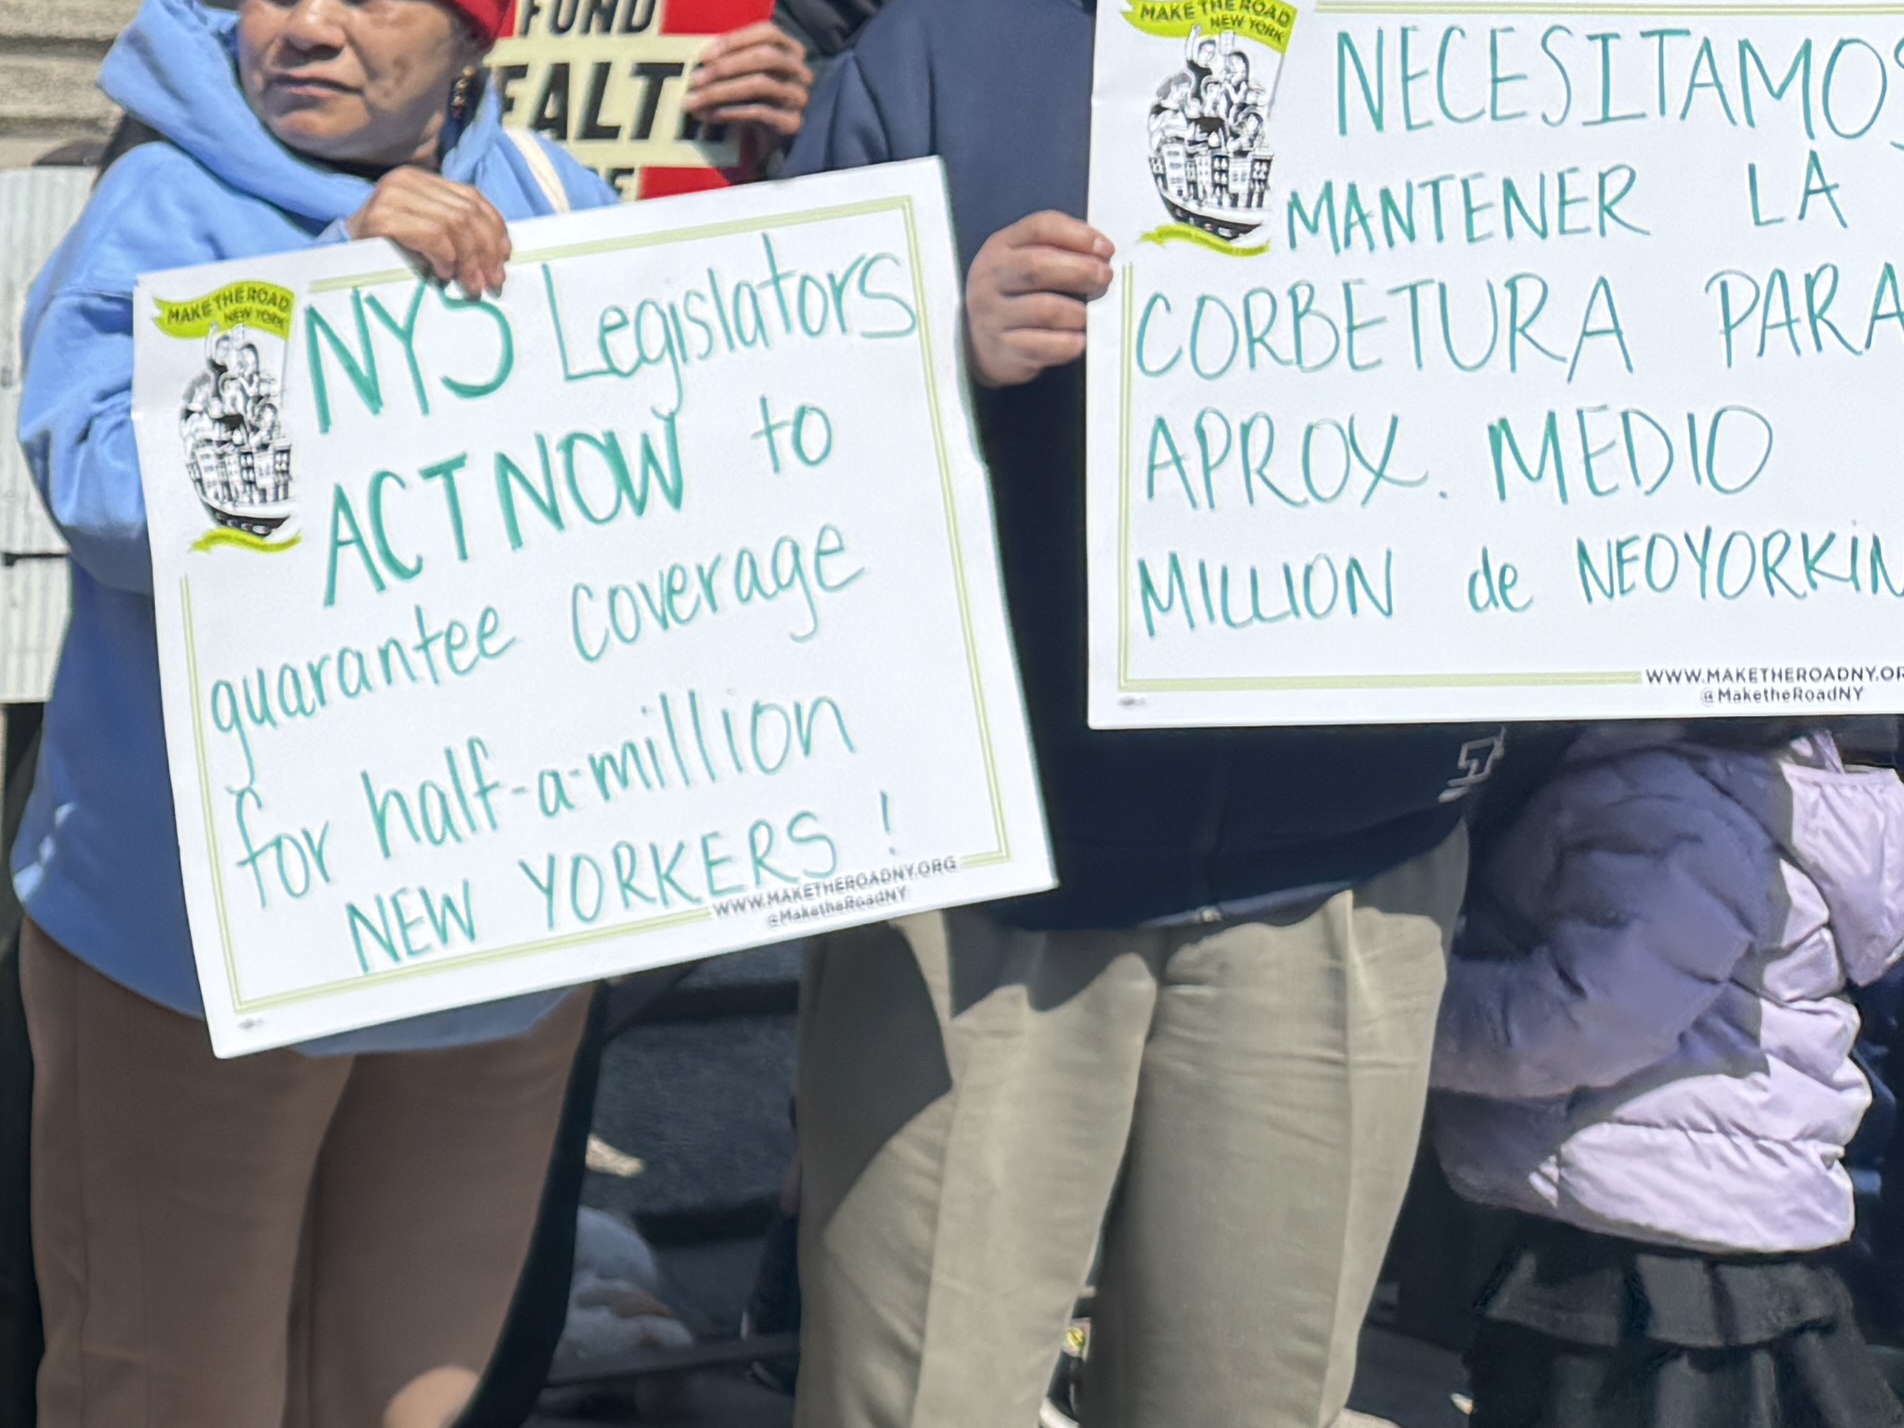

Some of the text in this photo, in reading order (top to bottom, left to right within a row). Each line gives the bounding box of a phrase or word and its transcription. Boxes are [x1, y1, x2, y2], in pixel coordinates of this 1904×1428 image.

[1141, 0, 1195, 21] MAKE
[1210, 14, 1284, 44] NEW YORK
[498, 62, 728, 143] EALT
[1288, 148, 1848, 257] MANTENER LA
[168, 285, 290, 323] MAKE THE ROAD
[225, 307, 286, 330] NEW YORK
[301, 233, 920, 434] NYS Legislators
[1135, 262, 1904, 383] CORBETURA PARA
[324, 393, 834, 608] ACT NOW to
[1144, 405, 1774, 510] APROX. MEDIO
[1138, 548, 1394, 638] MILLION
[1468, 547, 1534, 614] de
[209, 523, 866, 785] guarantee coverage
[1702, 686, 1864, 708] @MaketheRoadNY
[235, 687, 856, 910] for half-a-million
[346, 879, 479, 974] NEW
[712, 856, 958, 917] WWW.MAKETHEROADNY.ORG
[767, 886, 908, 928] @MaketheRoadNY
